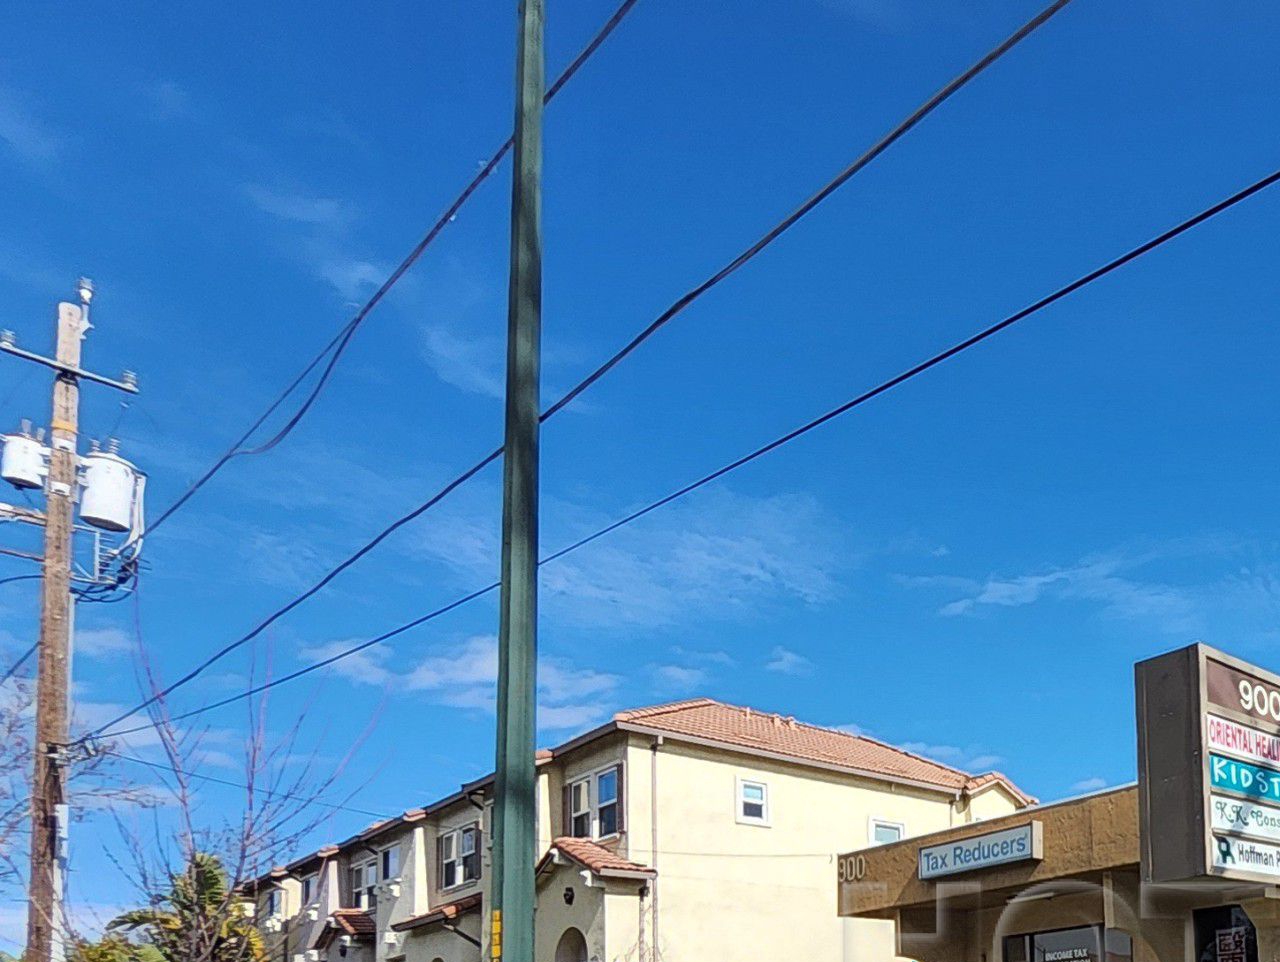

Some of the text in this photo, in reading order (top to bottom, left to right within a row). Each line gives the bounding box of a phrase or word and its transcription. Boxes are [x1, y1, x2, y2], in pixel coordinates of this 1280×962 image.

[1209, 719, 1253, 754] ORIENTAL
[924, 852, 948, 871] Tax
[1238, 844, 1274, 867] Hoffman
[1045, 948, 1088, 961] INCOME TAX
